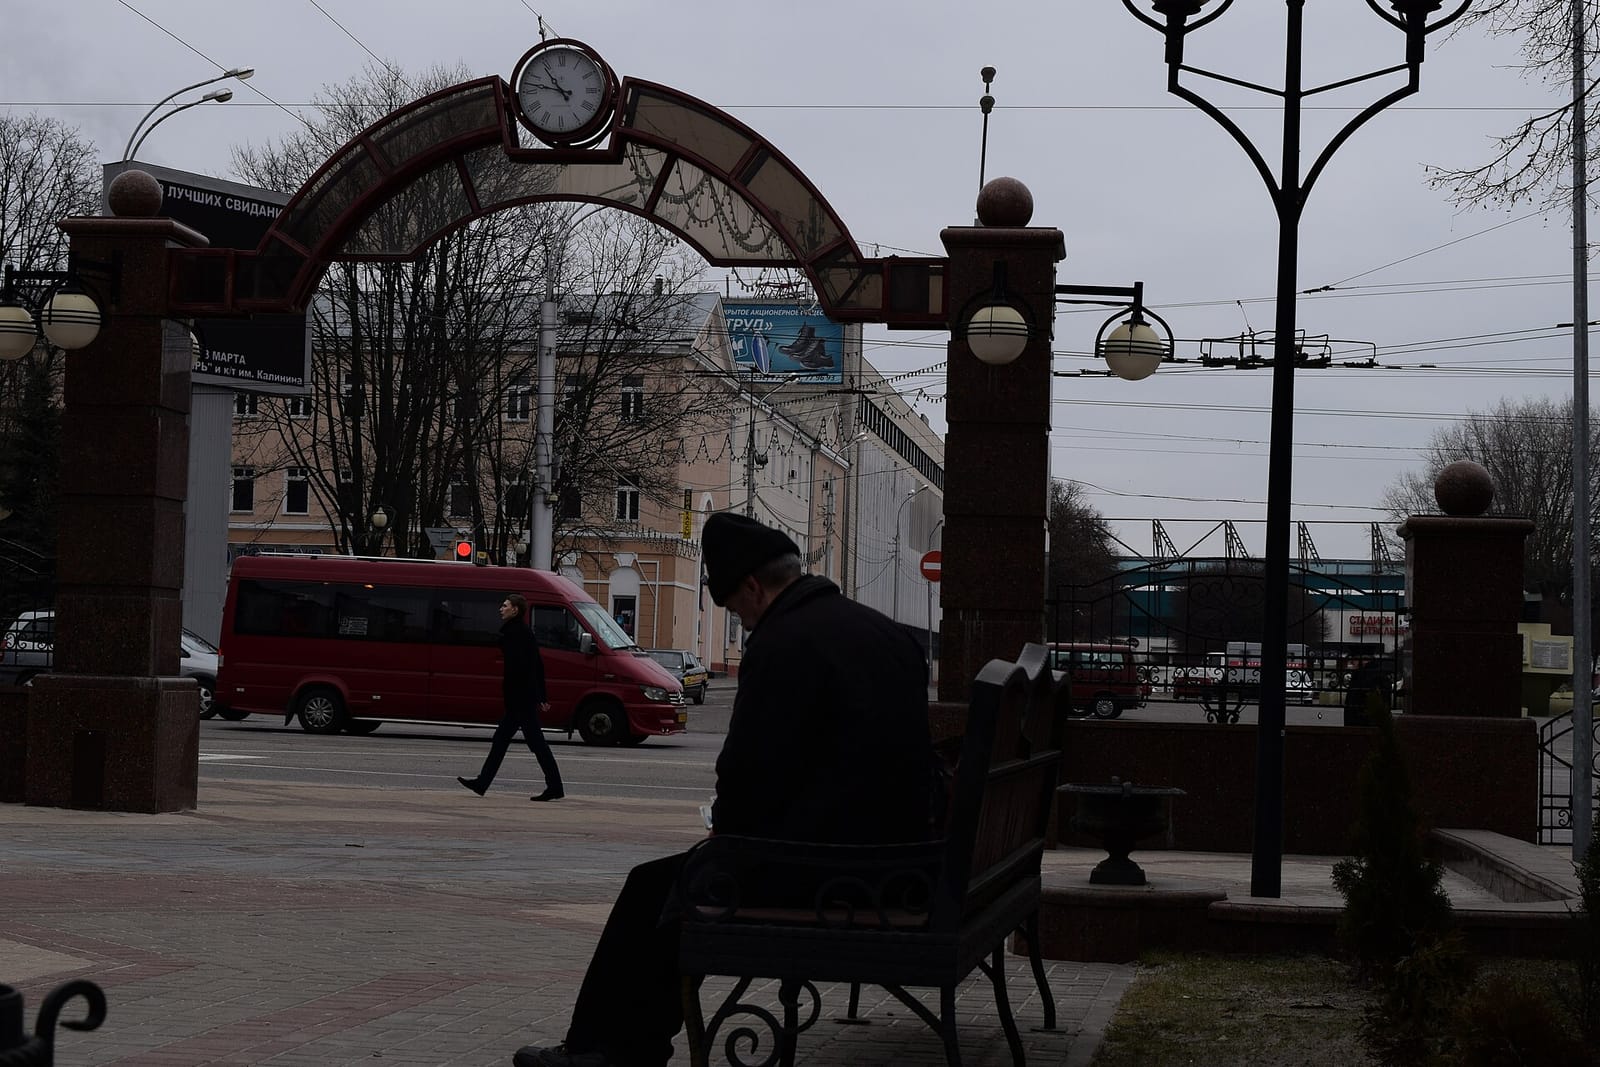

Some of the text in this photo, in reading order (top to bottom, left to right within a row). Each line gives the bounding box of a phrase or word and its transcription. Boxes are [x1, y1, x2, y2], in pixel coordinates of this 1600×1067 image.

[168, 185, 222, 208] ЛУЧШИХ
[750, 309, 799, 317] АКЦИОНЕРНОЕ
[212, 350, 246, 365] МАРТА
[215, 366, 221, 374] и
[239, 369, 254, 379] им.
[257, 369, 303, 385] Калинина
[1350, 615, 1394, 625] СТАДИОН
